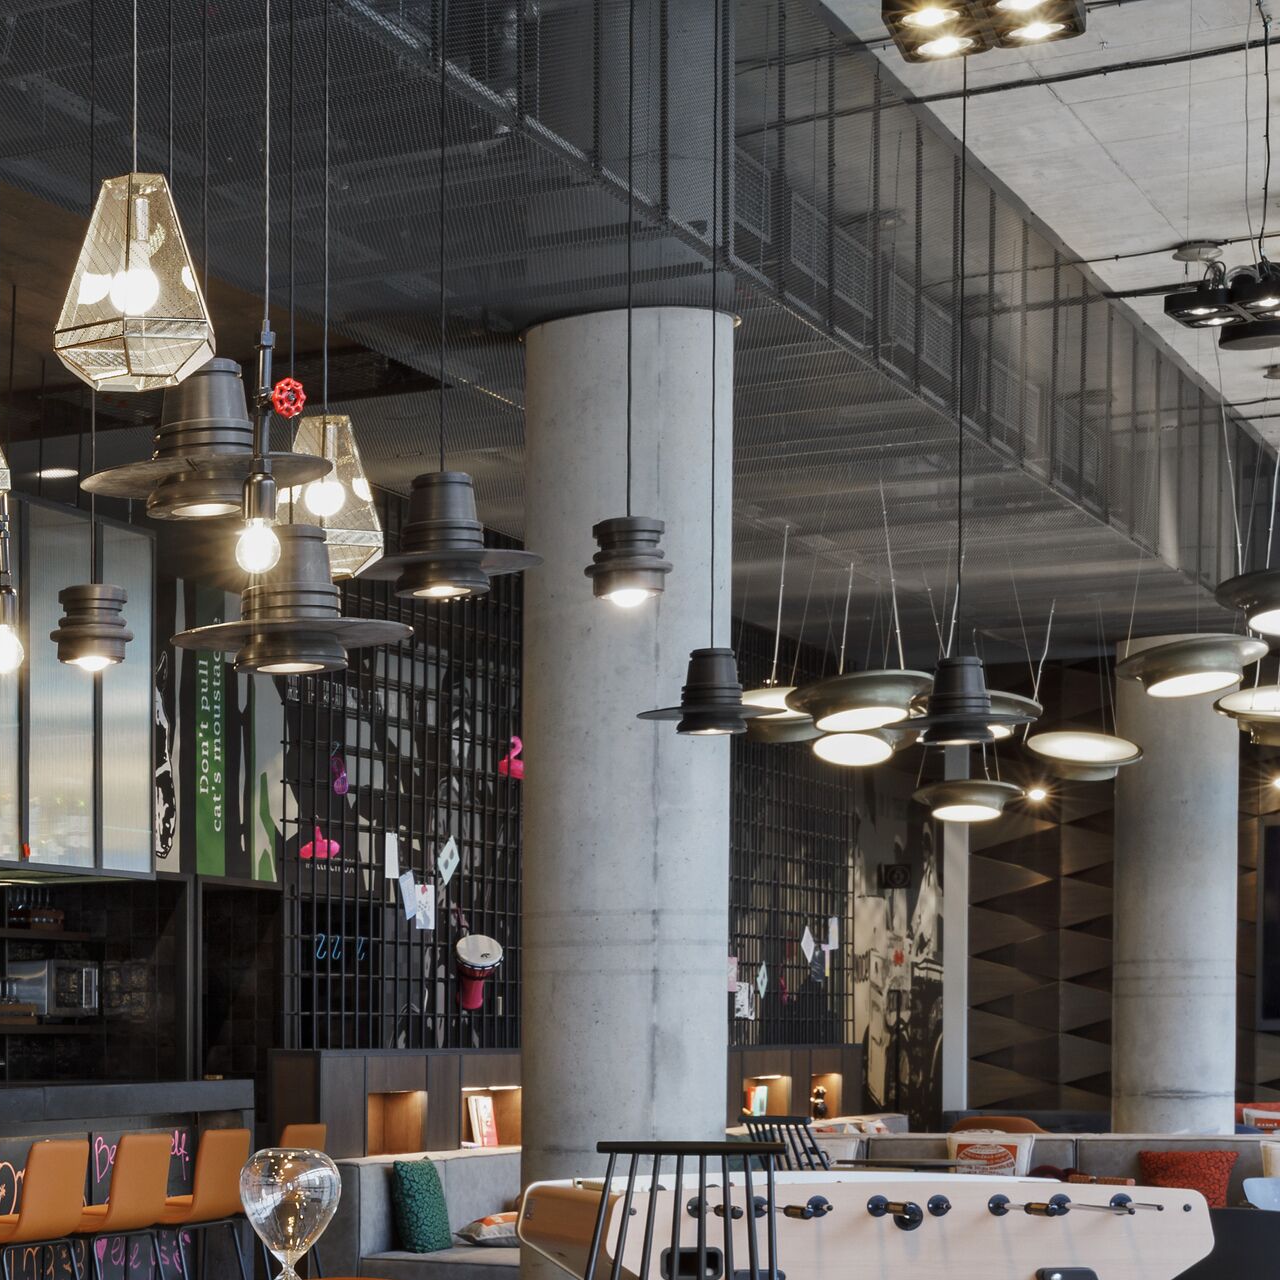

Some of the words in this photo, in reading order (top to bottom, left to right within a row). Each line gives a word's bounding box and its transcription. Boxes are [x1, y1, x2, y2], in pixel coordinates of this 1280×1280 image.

[198, 659, 210, 711] pull
[199, 720, 209, 794] Don't
[212, 772, 222, 833] cat's
